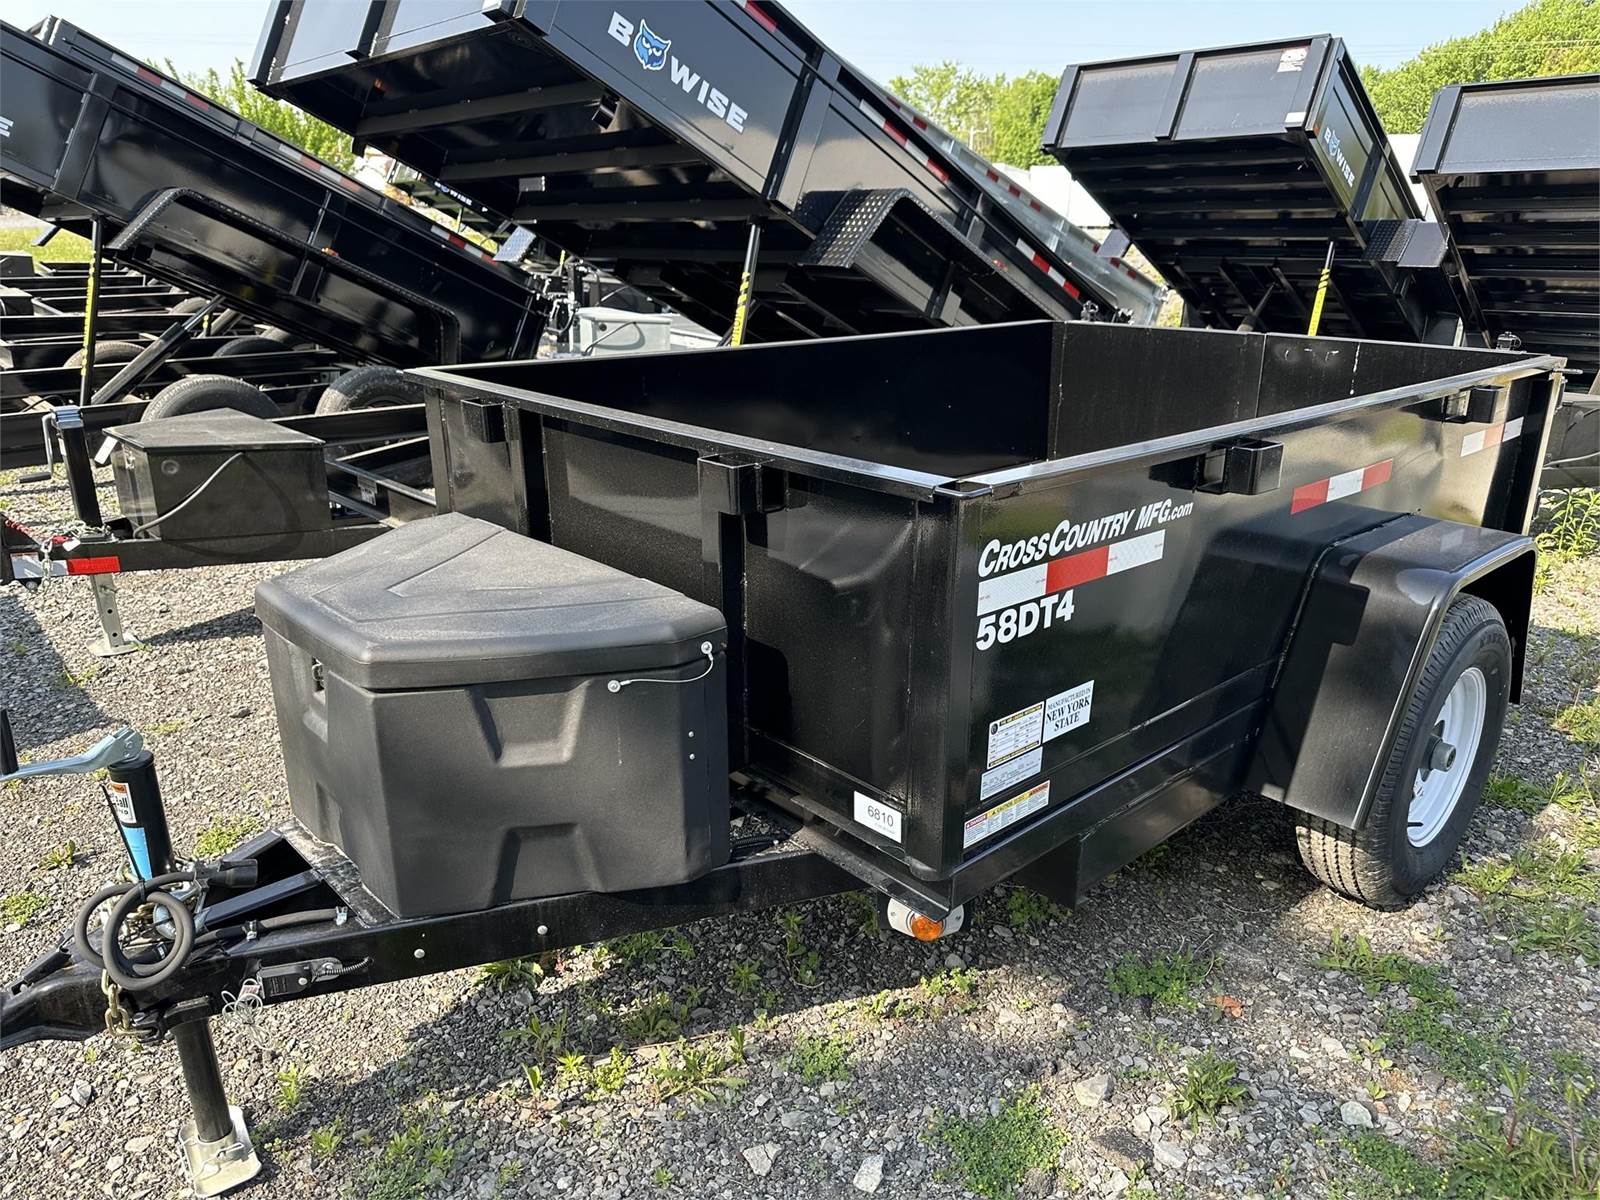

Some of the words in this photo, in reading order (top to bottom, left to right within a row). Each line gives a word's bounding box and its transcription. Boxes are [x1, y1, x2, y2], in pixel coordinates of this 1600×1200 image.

[1134, 498, 1194, 531] MFG.com
[976, 589, 1075, 651] 58DT4
[1046, 705, 1066, 724] NEW
[1067, 694, 1091, 714] YORK
[1054, 711, 1080, 732] STATE
[867, 805, 894, 827] 6810
